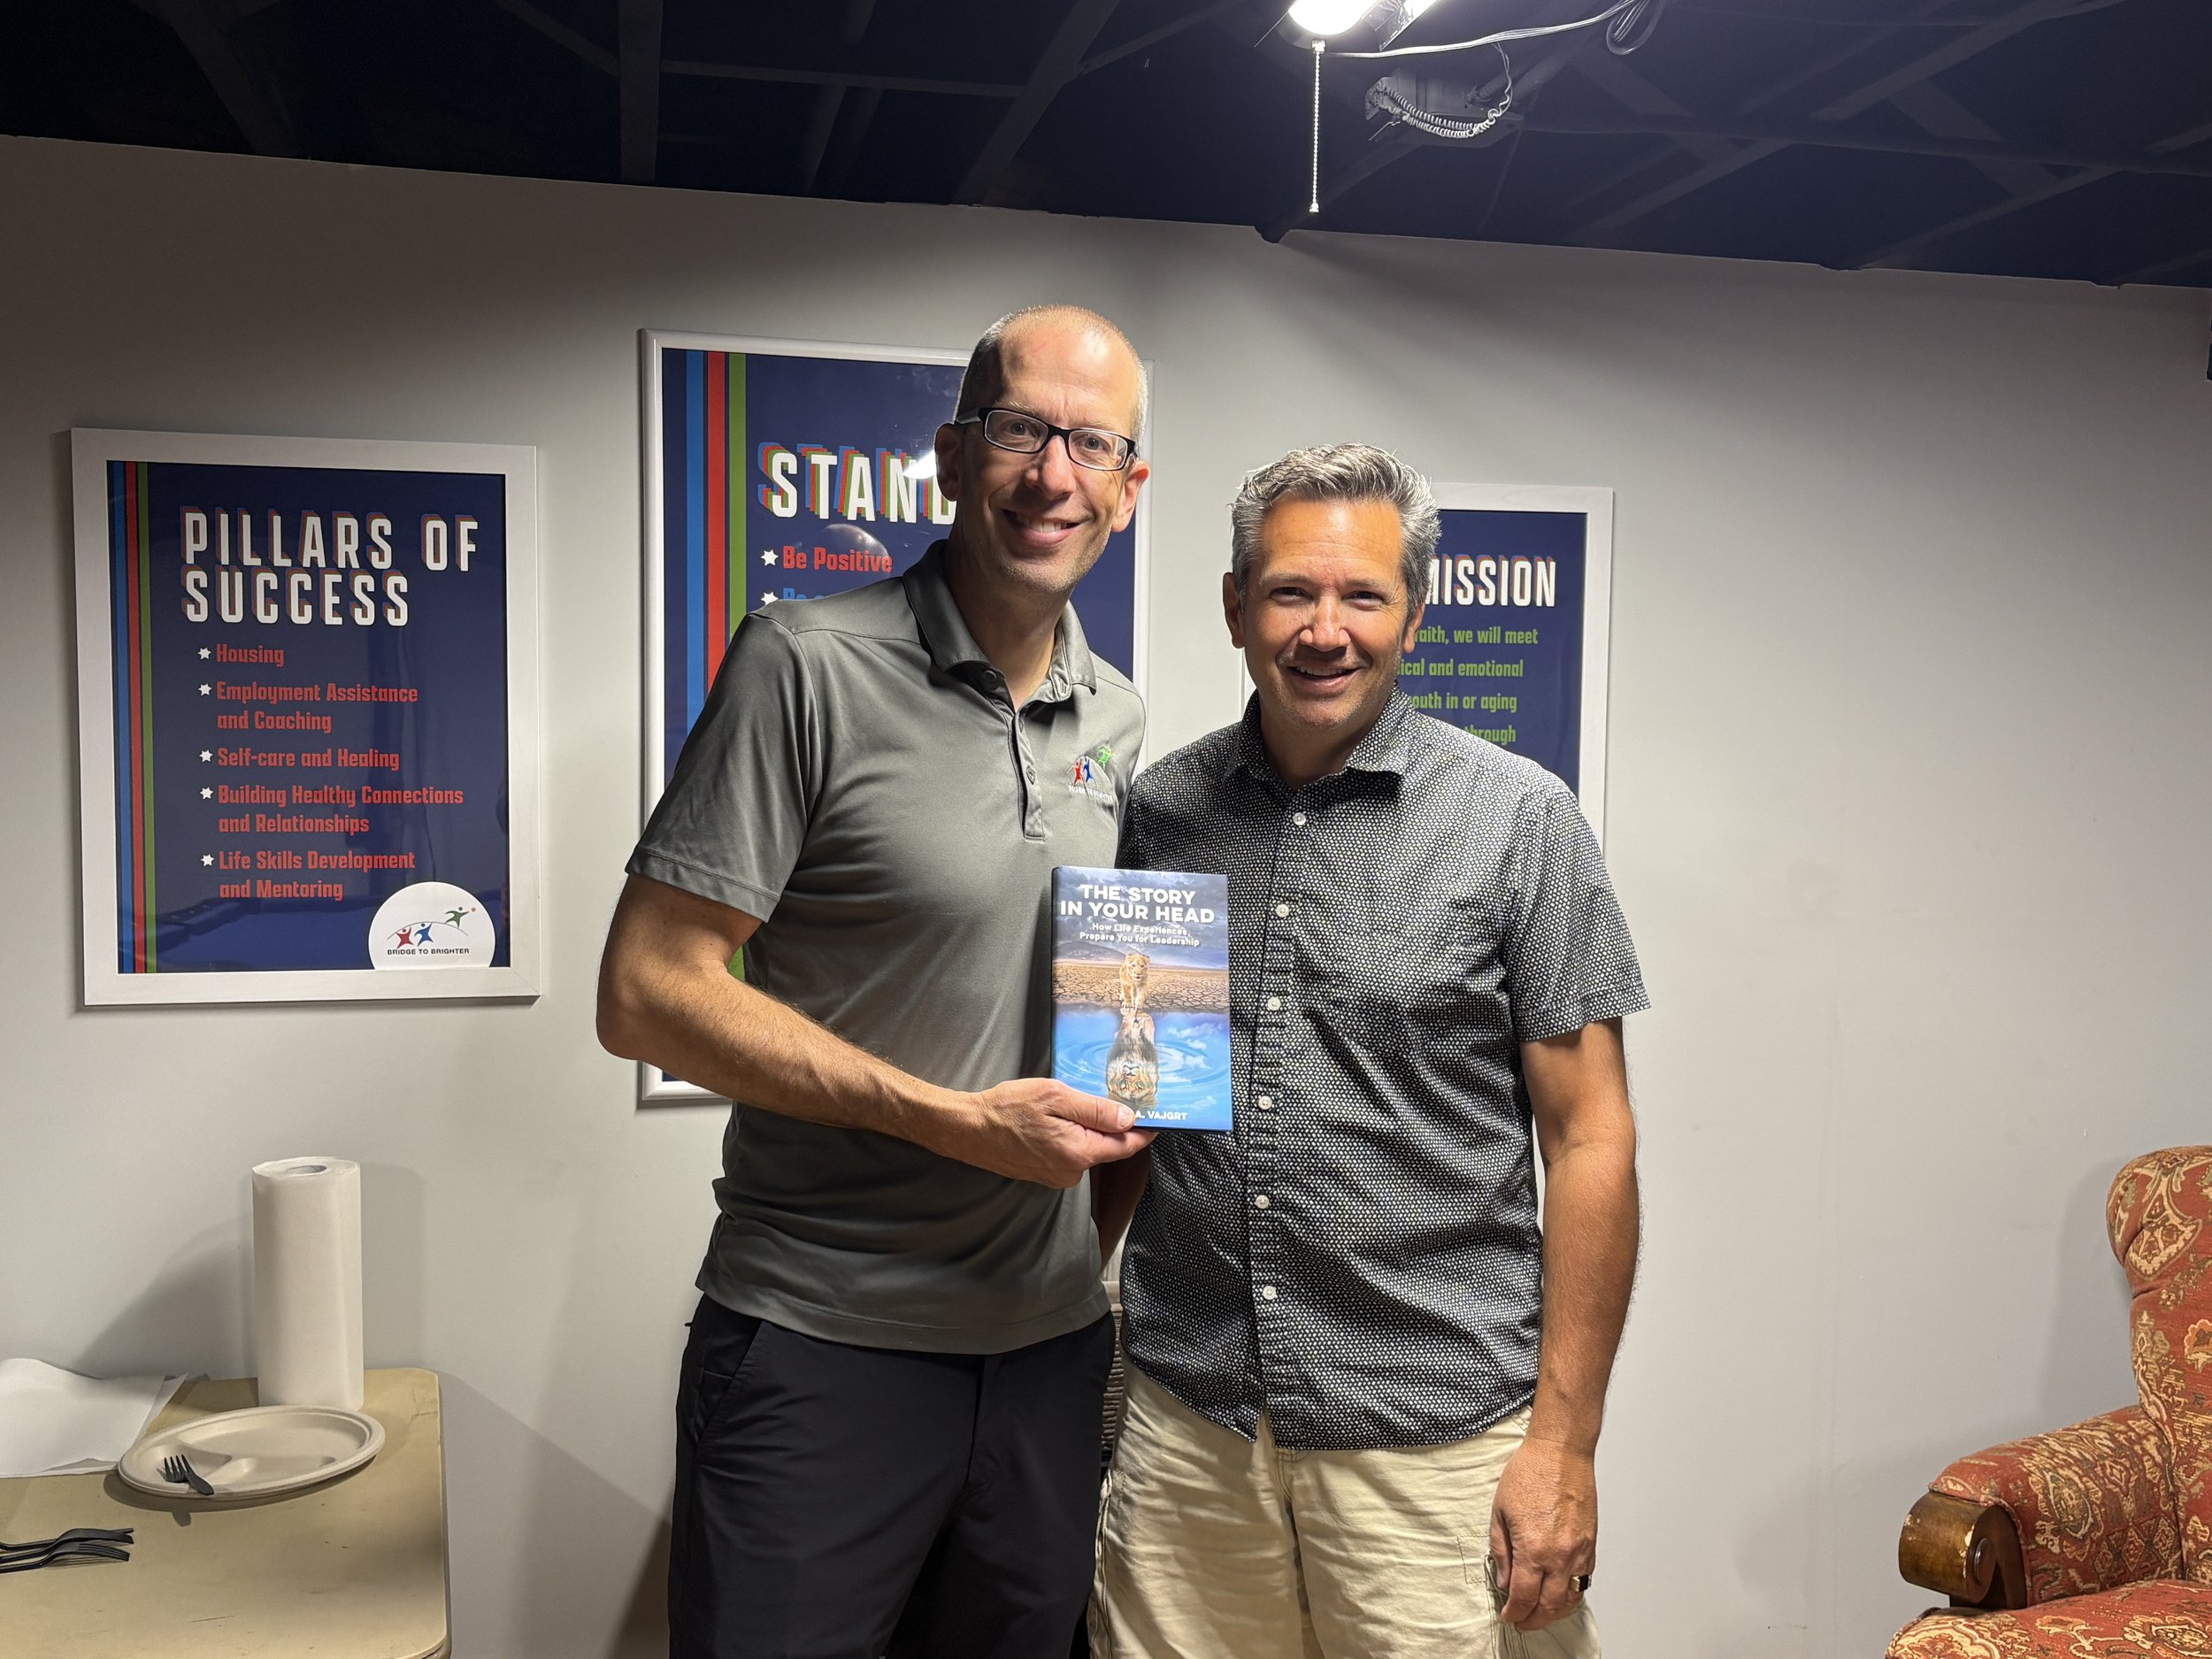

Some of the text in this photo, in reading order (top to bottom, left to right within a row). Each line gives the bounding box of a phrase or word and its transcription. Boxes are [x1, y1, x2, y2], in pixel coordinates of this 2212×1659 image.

[183, 509, 479, 572] PILLARS OF
[782, 545, 893, 573] Be Positive
[183, 569, 409, 626] SUCCESS
[1454, 630, 1473, 643] we
[1477, 626, 1501, 643] will
[1505, 628, 1538, 644] meet
[216, 643, 285, 667] Housing
[1397, 657, 1524, 677] ical and emotional
[217, 681, 419, 704] Employment Assistance
[1446, 692, 1458, 709] in
[1463, 696, 1477, 709] or
[1480, 693, 1517, 713] aging
[217, 710, 332, 733] and Coaching
[1464, 725, 1517, 746] hrough
[218, 748, 400, 772] Self-care and Healing
[219, 785, 465, 808] Building Healthy Connections
[219, 814, 369, 835] and Relationships
[219, 851, 416, 872] Life Skills Development
[219, 879, 343, 901] and Mentoring
[1079, 884, 1196, 905] THE STORY
[1060, 900, 1215, 924] IN YOUR HEAD
[1079, 932, 1200, 948] Prepare You for Leadership
[1114, 923, 1132, 933] Life
[1133, 925, 1187, 936] Experiences
[1135, 1110, 1146, 1119] A.
